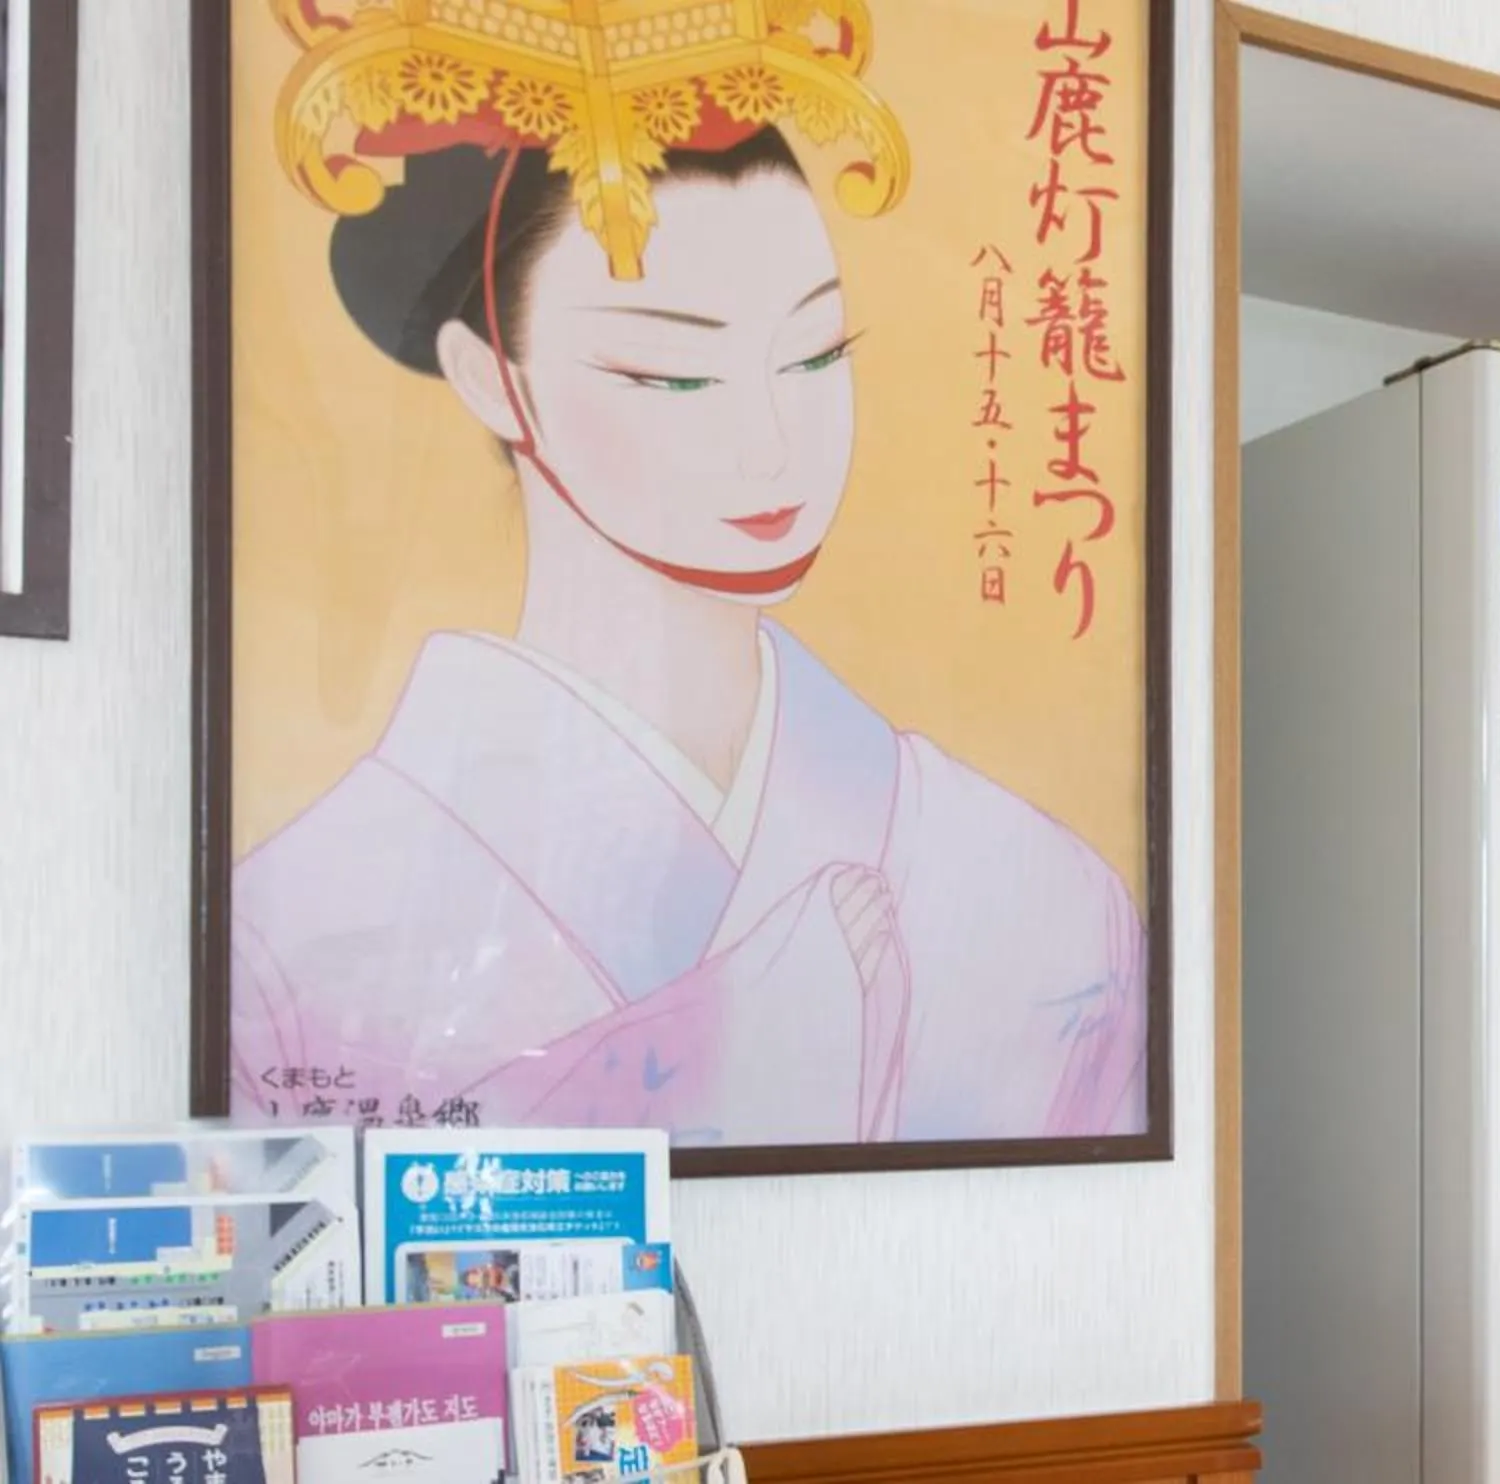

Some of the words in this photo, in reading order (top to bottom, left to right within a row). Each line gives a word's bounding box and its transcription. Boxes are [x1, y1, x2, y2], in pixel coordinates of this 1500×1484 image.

[1025, 0, 1126, 640] 山鹿灯籠まつり
[260, 1065, 357, 1089] くまもと
[443, 1168, 572, 1196] 感症対策
